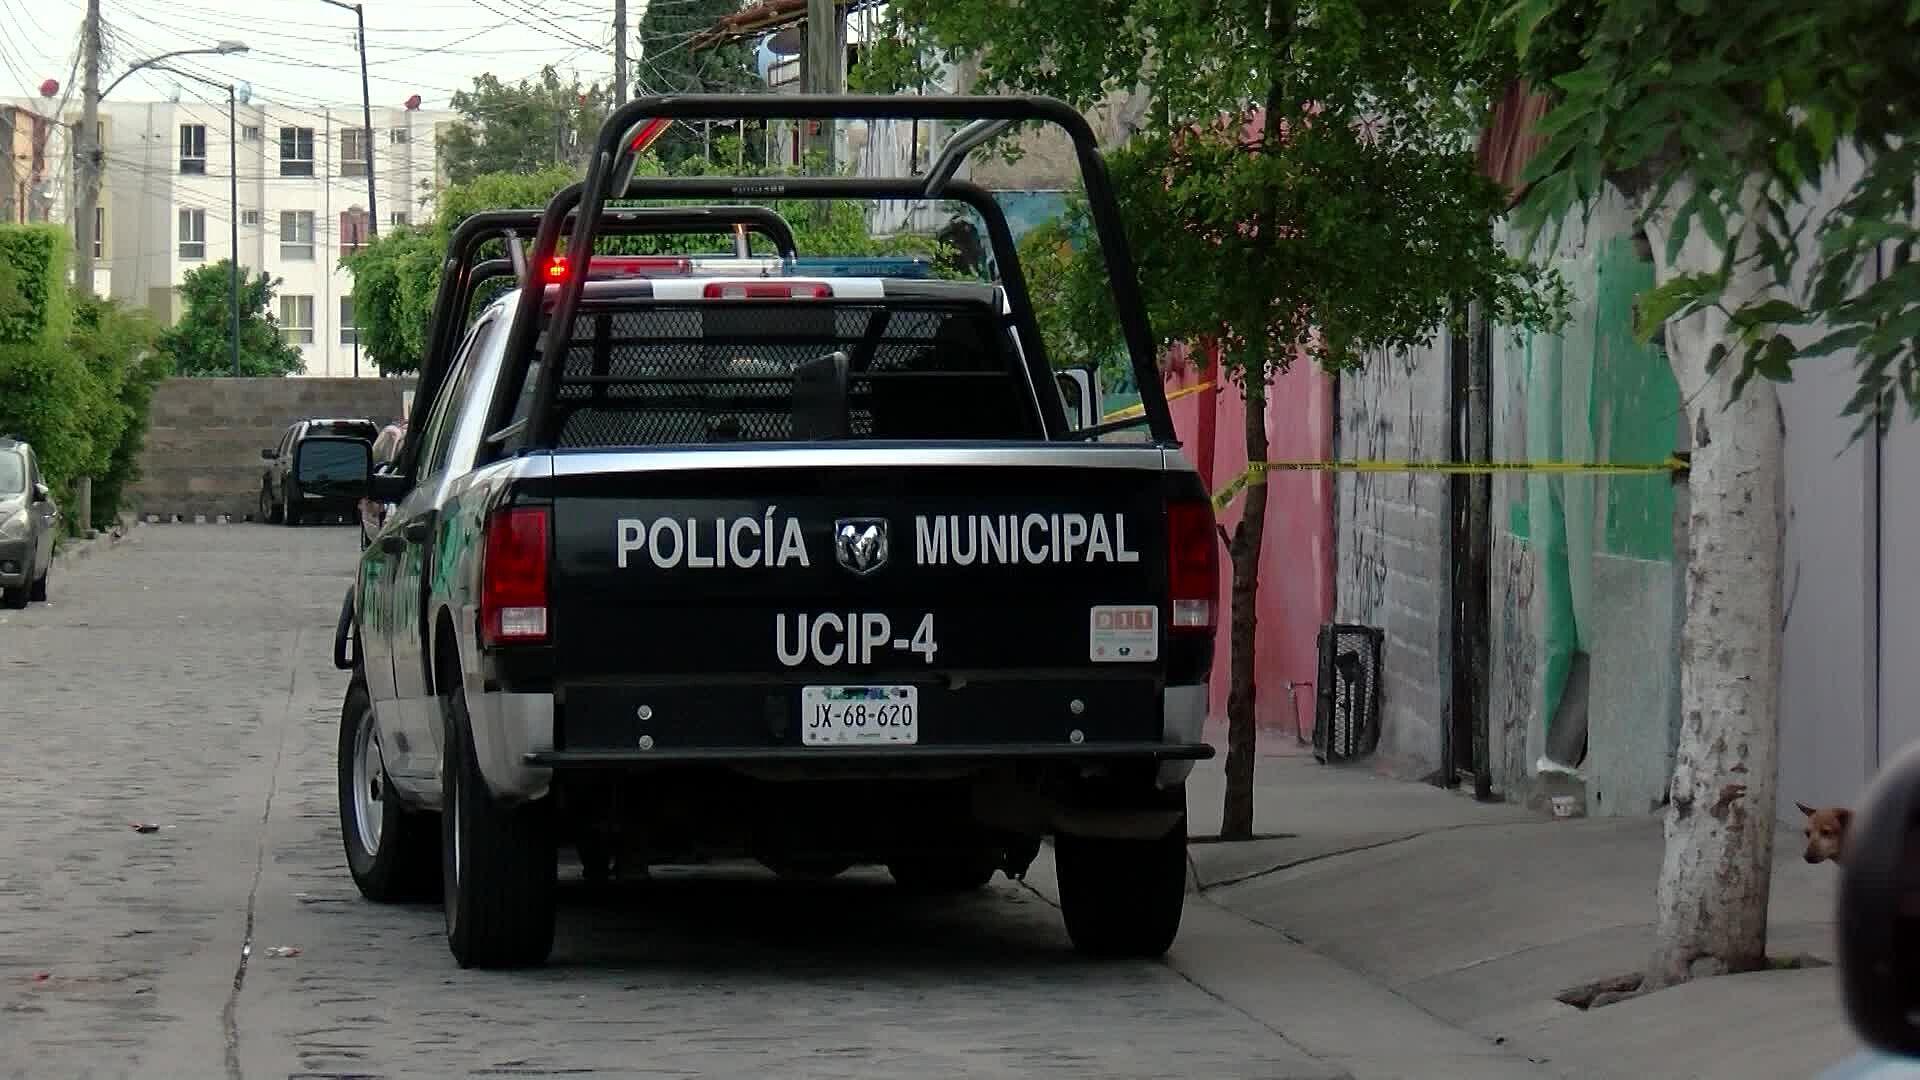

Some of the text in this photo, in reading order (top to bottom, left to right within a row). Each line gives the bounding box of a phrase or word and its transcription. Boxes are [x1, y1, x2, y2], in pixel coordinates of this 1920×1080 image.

[617, 505, 1139, 568] POLICÍA MUNICIPAL
[776, 612, 938, 666] UCIP-4
[809, 703, 913, 728] JX-68-620
